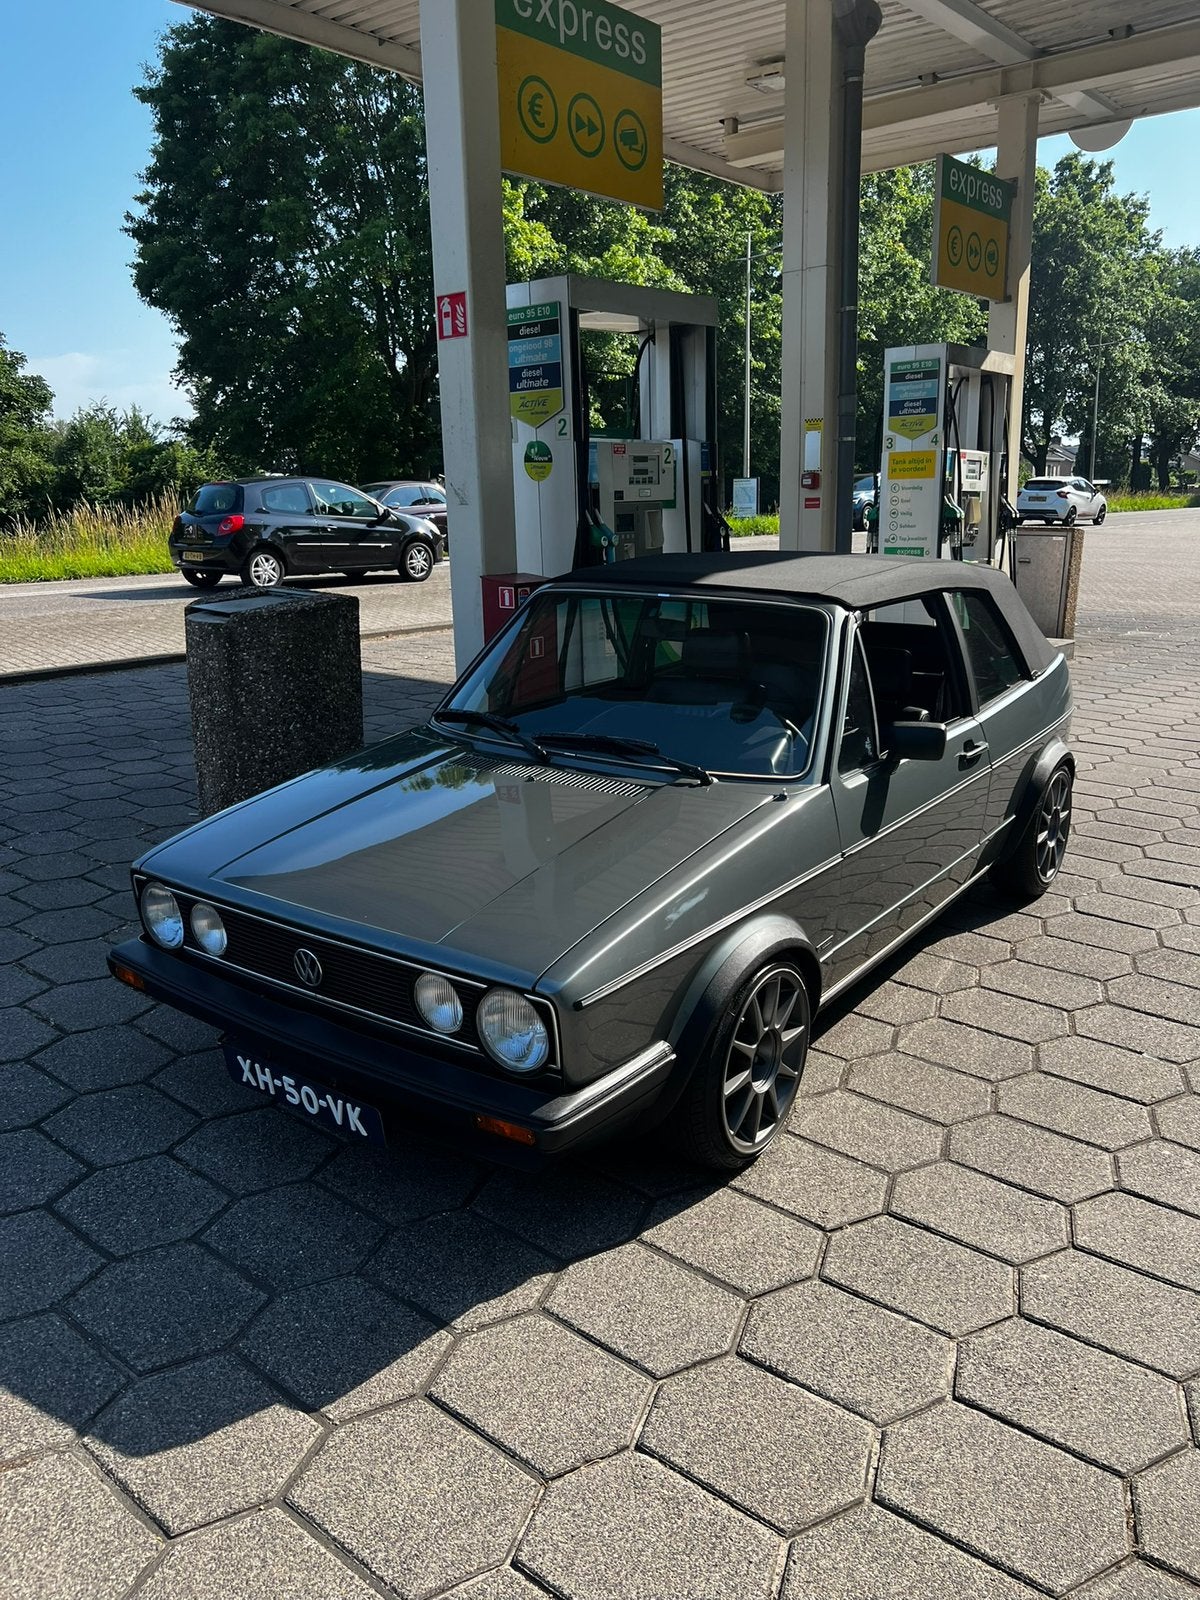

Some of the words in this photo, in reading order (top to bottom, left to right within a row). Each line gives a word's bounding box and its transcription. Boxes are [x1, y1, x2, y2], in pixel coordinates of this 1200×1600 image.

[950, 167, 1003, 209] express
[508, 312, 525, 321] euro
[526, 309, 536, 318] 95
[537, 306, 550, 316] E10
[519, 324, 541, 336] diesel
[508, 340, 542, 354] ongelood
[515, 352, 548, 364] ultimate
[521, 366, 543, 378] diesel
[905, 372, 923, 380] diesel
[516, 378, 549, 389] ultimate
[519, 399, 548, 408] ACTIVE
[904, 400, 922, 408] diesel
[899, 407, 927, 415] ultimate
[558, 418, 568, 436] 2
[886, 438, 894, 450] 3
[930, 434, 939, 446] 4
[664, 448, 672, 464] 2
[892, 458, 907, 466] Tank
[908, 457, 924, 466] altijd
[899, 465, 926, 473] voordeel
[236, 1056, 368, 1136] XH-50-VK
